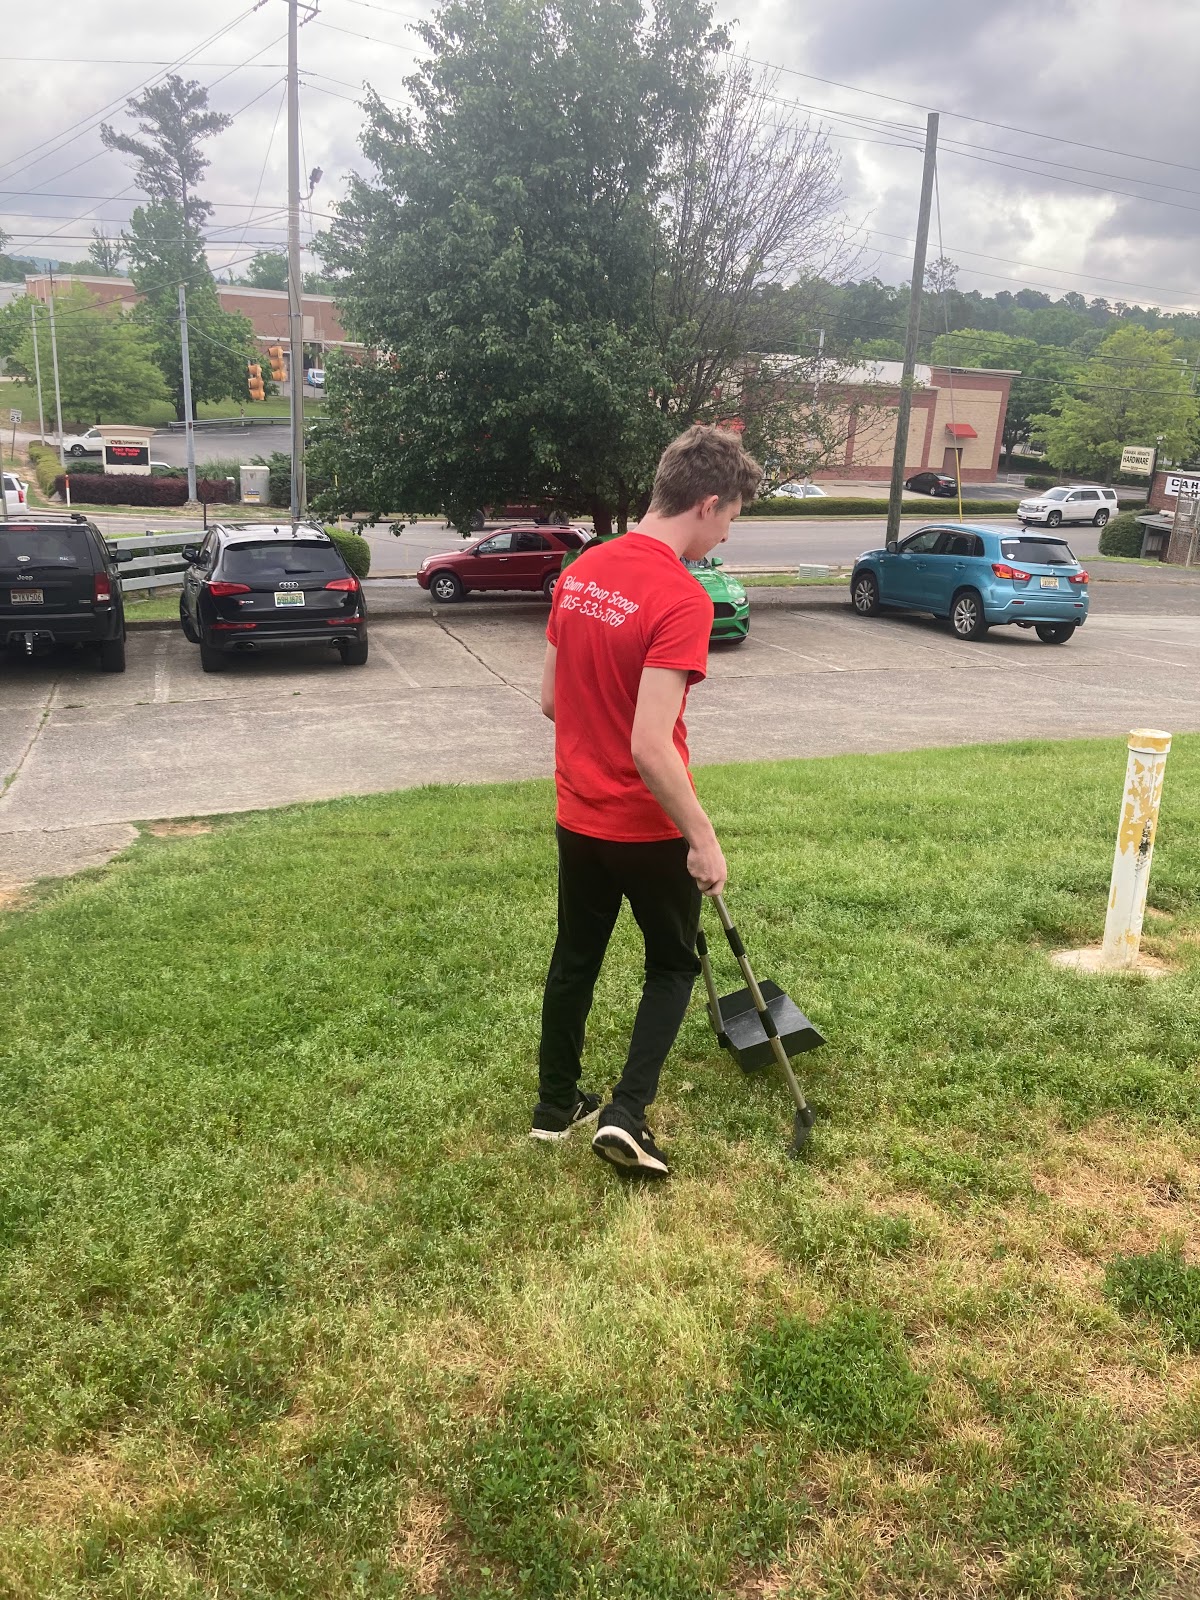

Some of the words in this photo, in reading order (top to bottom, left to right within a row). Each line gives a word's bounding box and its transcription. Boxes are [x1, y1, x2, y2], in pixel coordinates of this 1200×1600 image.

[1123, 456, 1149, 465] HARDWARE
[583, 581, 610, 603] Poop
[607, 591, 639, 615] Scoop
